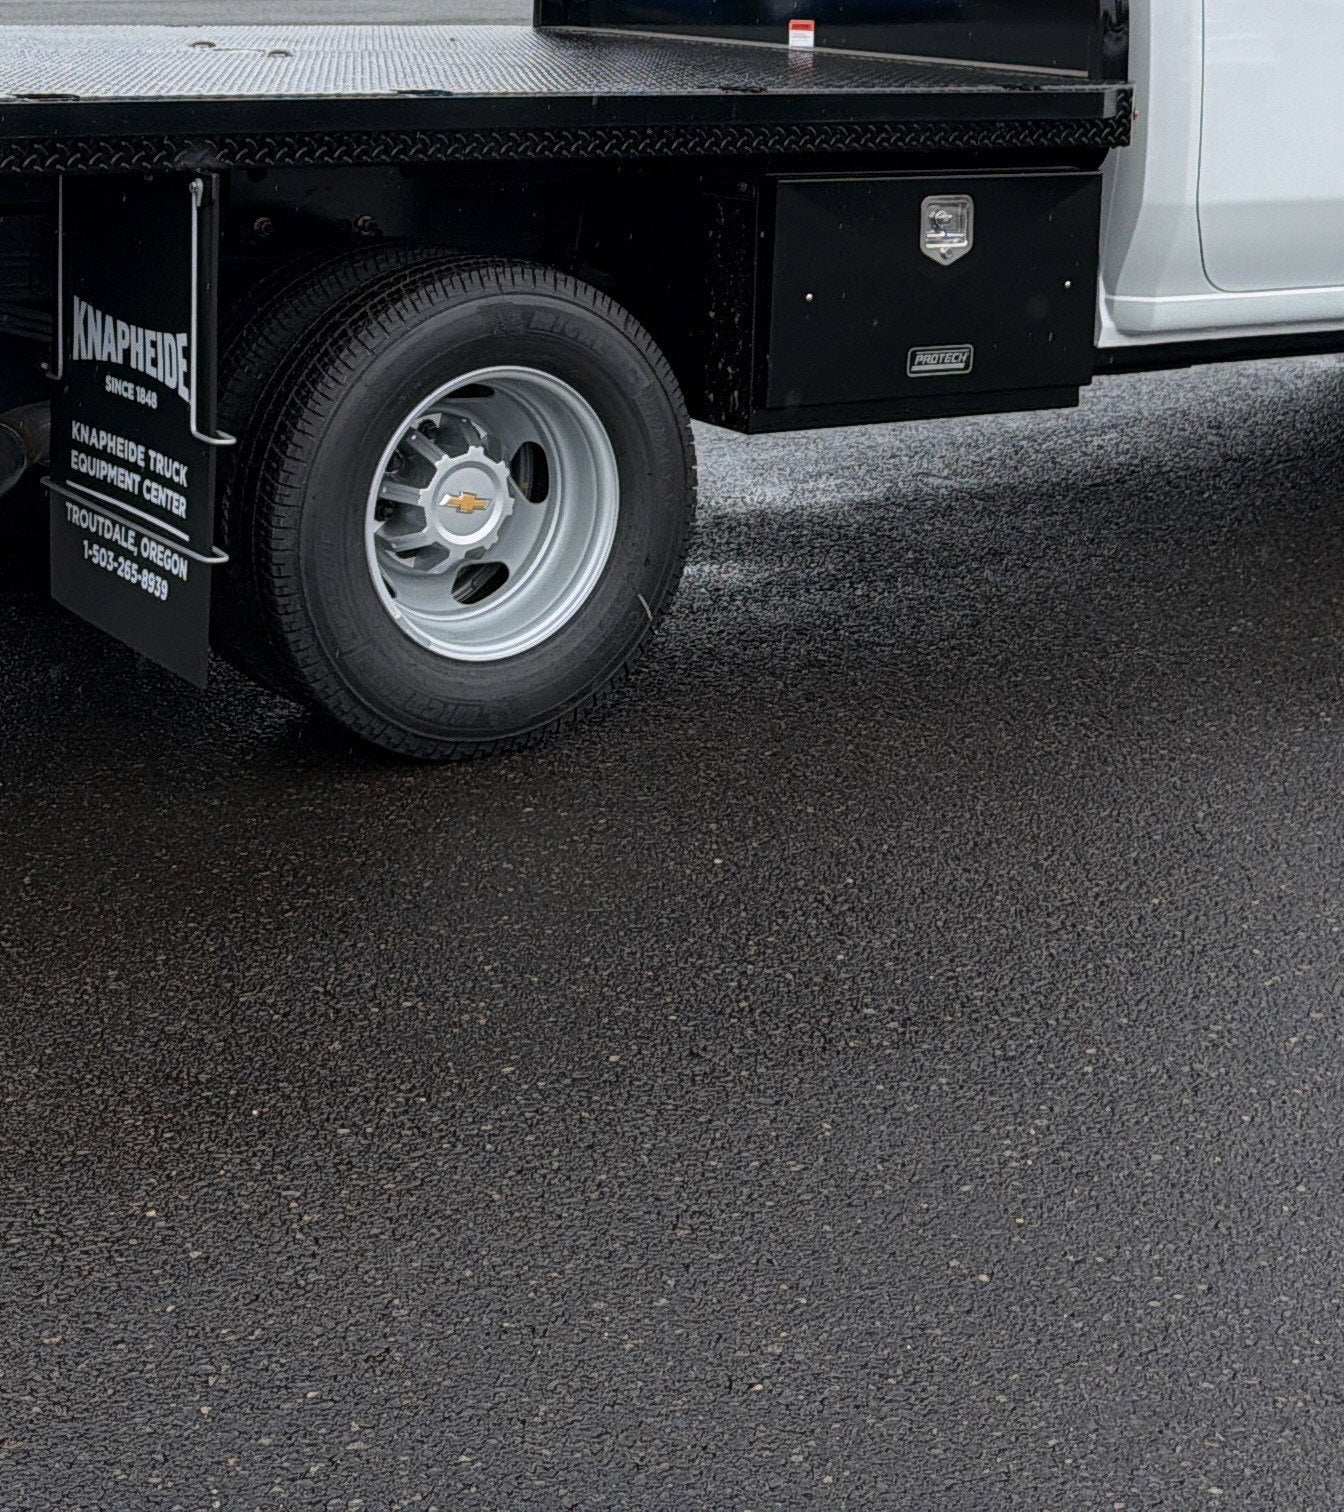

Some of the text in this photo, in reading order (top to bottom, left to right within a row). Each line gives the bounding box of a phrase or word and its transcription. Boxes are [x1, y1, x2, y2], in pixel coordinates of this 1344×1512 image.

[73, 294, 191, 406] KNAPHEIDE
[915, 352, 969, 365] PROTECH
[105, 374, 157, 409] SINCE 1848
[71, 420, 188, 487] KNAPHEIDE TRUCK
[71, 449, 187, 519] EQUIPMENT CENTER
[65, 501, 188, 581] TROUTDALE, OREGON
[83, 539, 168, 601] 1-503-265-8939
